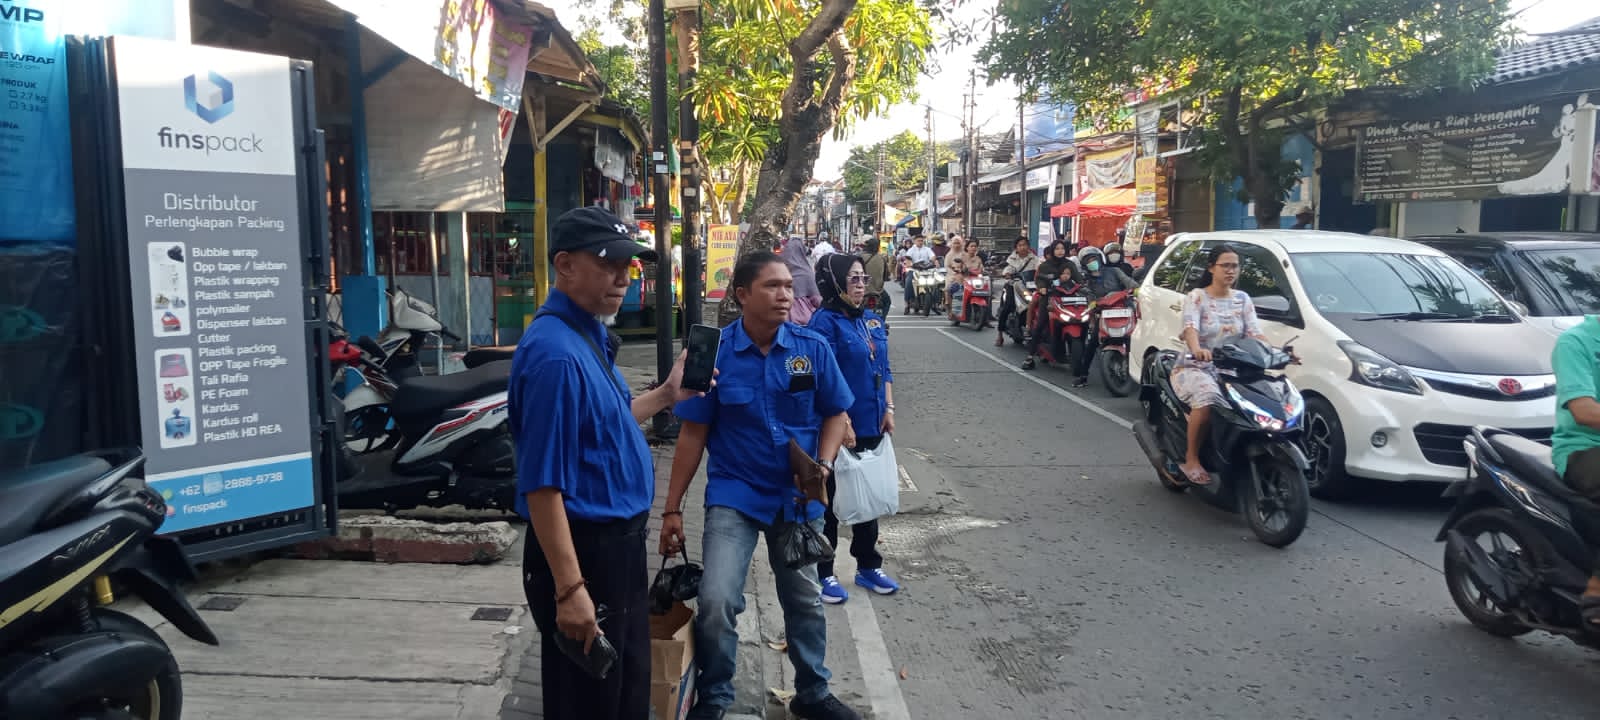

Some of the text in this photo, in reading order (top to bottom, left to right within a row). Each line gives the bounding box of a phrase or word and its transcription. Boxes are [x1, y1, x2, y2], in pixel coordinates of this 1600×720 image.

[158, 126, 264, 156] finspack
[164, 192, 258, 212] Distributor
[145, 216, 284, 231] Perlengkapan Packing
[192, 247, 258, 258] Bubble wrap
[193, 262, 215, 273] Opp
[218, 262, 241, 272] tape
[253, 260, 287, 270] lakban
[194, 276, 279, 286] Plastik wrapping
[195, 288, 274, 300] Plastik sampah
[196, 304, 250, 316] polymailer
[197, 316, 286, 329] Dispenser lakban
[198, 334, 231, 343] Cutter
[199, 344, 276, 356] Plastik packing
[200, 356, 287, 371] OPP Tape Fragile
[200, 373, 248, 385] Tali Rafia
[201, 388, 248, 400] PE Foam
[202, 403, 239, 414] Kardus
[203, 413, 258, 428] Kardus roll
[204, 424, 282, 442] Plastik HD REA
[179, 485, 200, 496] +62
[184, 500, 227, 514] finspack
